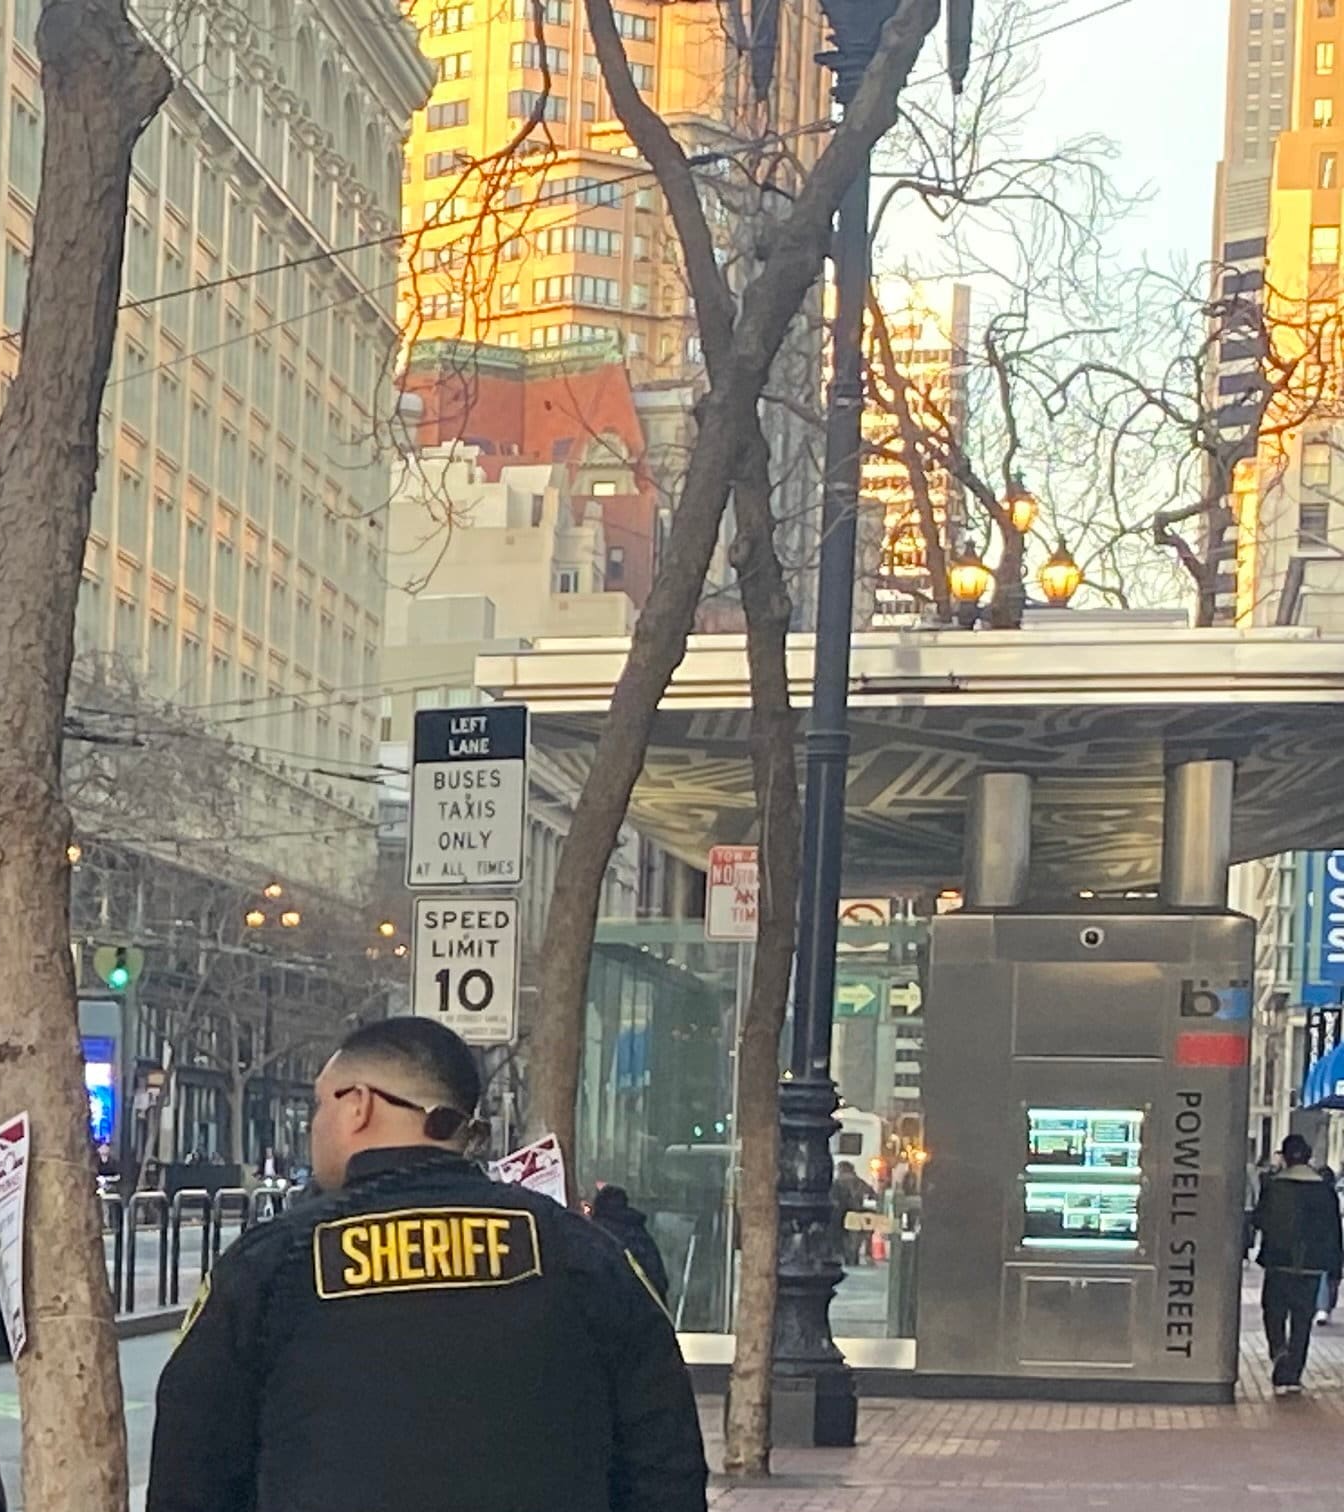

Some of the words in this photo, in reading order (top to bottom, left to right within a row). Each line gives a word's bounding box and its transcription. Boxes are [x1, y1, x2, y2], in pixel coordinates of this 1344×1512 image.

[450, 716, 488, 735] LEFT
[448, 738, 491, 756] LANE
[433, 769, 501, 790] BUSES
[438, 800, 497, 820] TAXIS
[438, 831, 492, 851] ONLY
[416, 862, 431, 877] AT
[441, 862, 464, 877] ALL
[477, 860, 514, 876] TIMES
[713, 864, 733, 883] NO
[424, 910, 510, 930] SPEED
[432, 939, 500, 959] LIMIT
[434, 968, 494, 1012] 10
[1170, 1091, 1202, 1225] POWELL
[341, 1218, 511, 1286] SHERIFF
[1165, 1239, 1197, 1359] STREET
